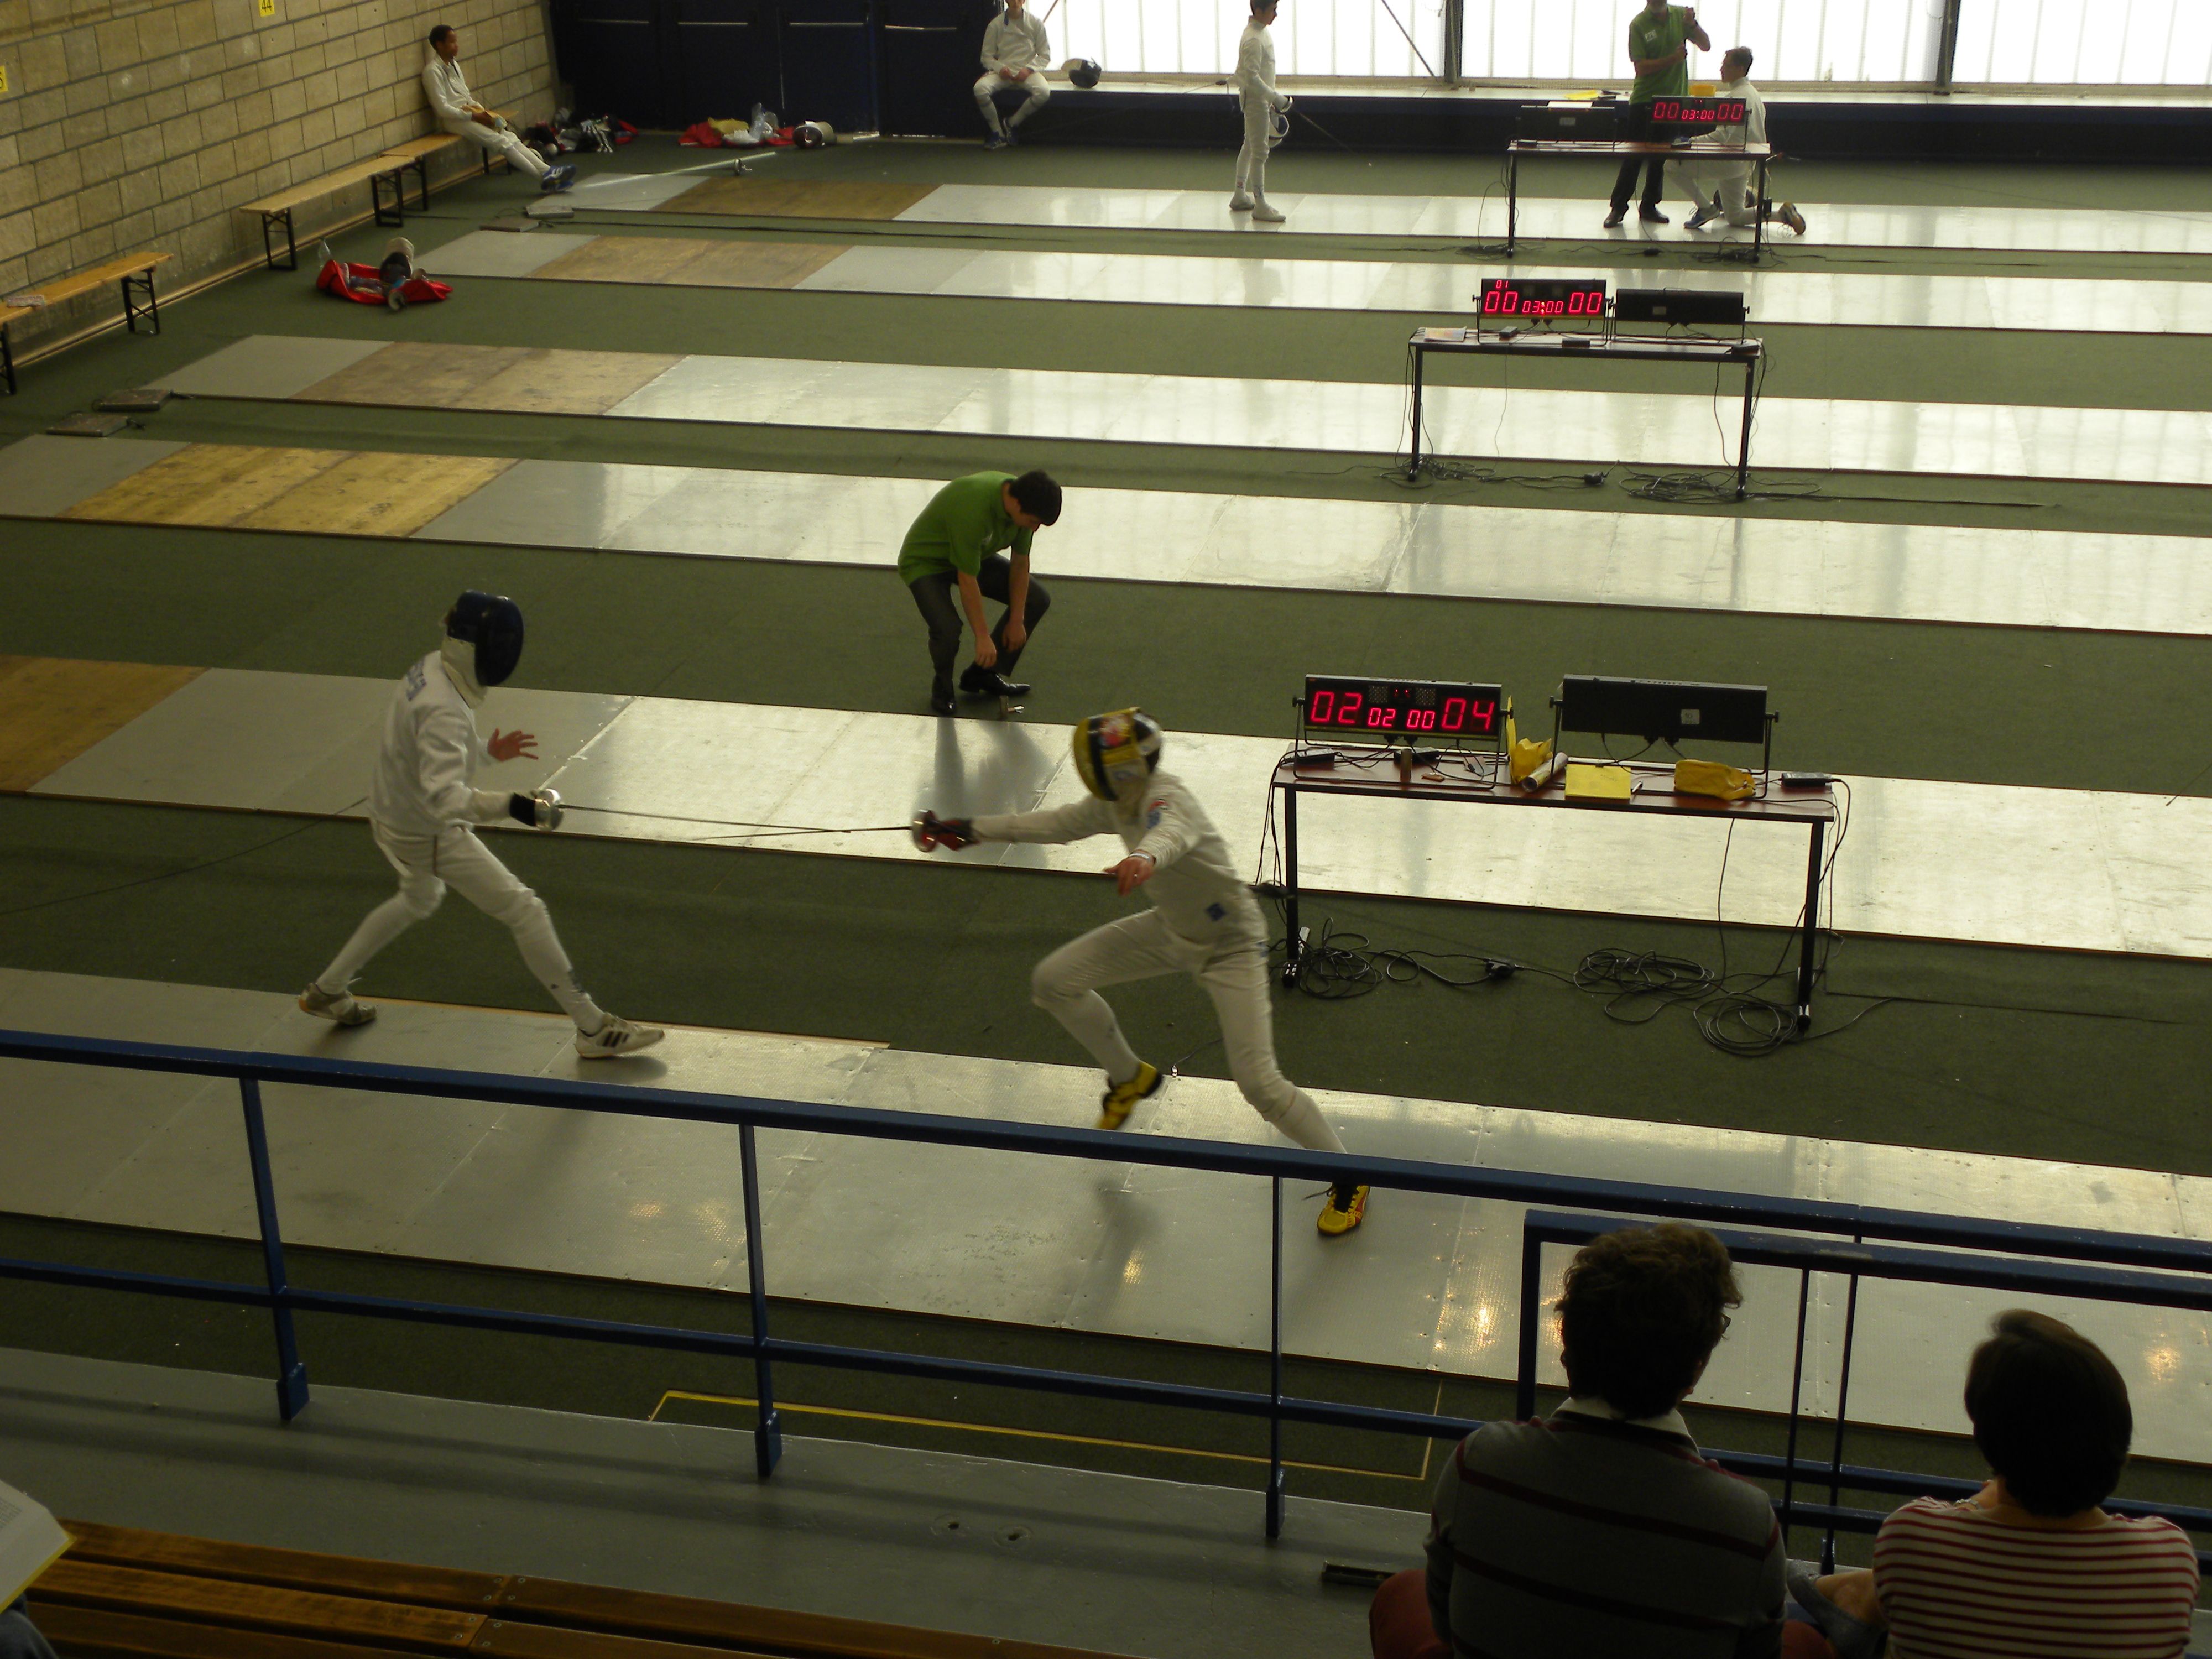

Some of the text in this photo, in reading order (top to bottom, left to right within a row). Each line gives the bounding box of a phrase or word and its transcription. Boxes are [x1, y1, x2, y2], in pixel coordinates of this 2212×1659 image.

[262, 0, 272, 12] 44
[1653, 102, 1743, 119] 00 03:00 00
[1495, 280, 1509, 289] 01
[1484, 291, 1603, 313] 00 03:00 00
[1310, 691, 1495, 731] 02 02 00 04
